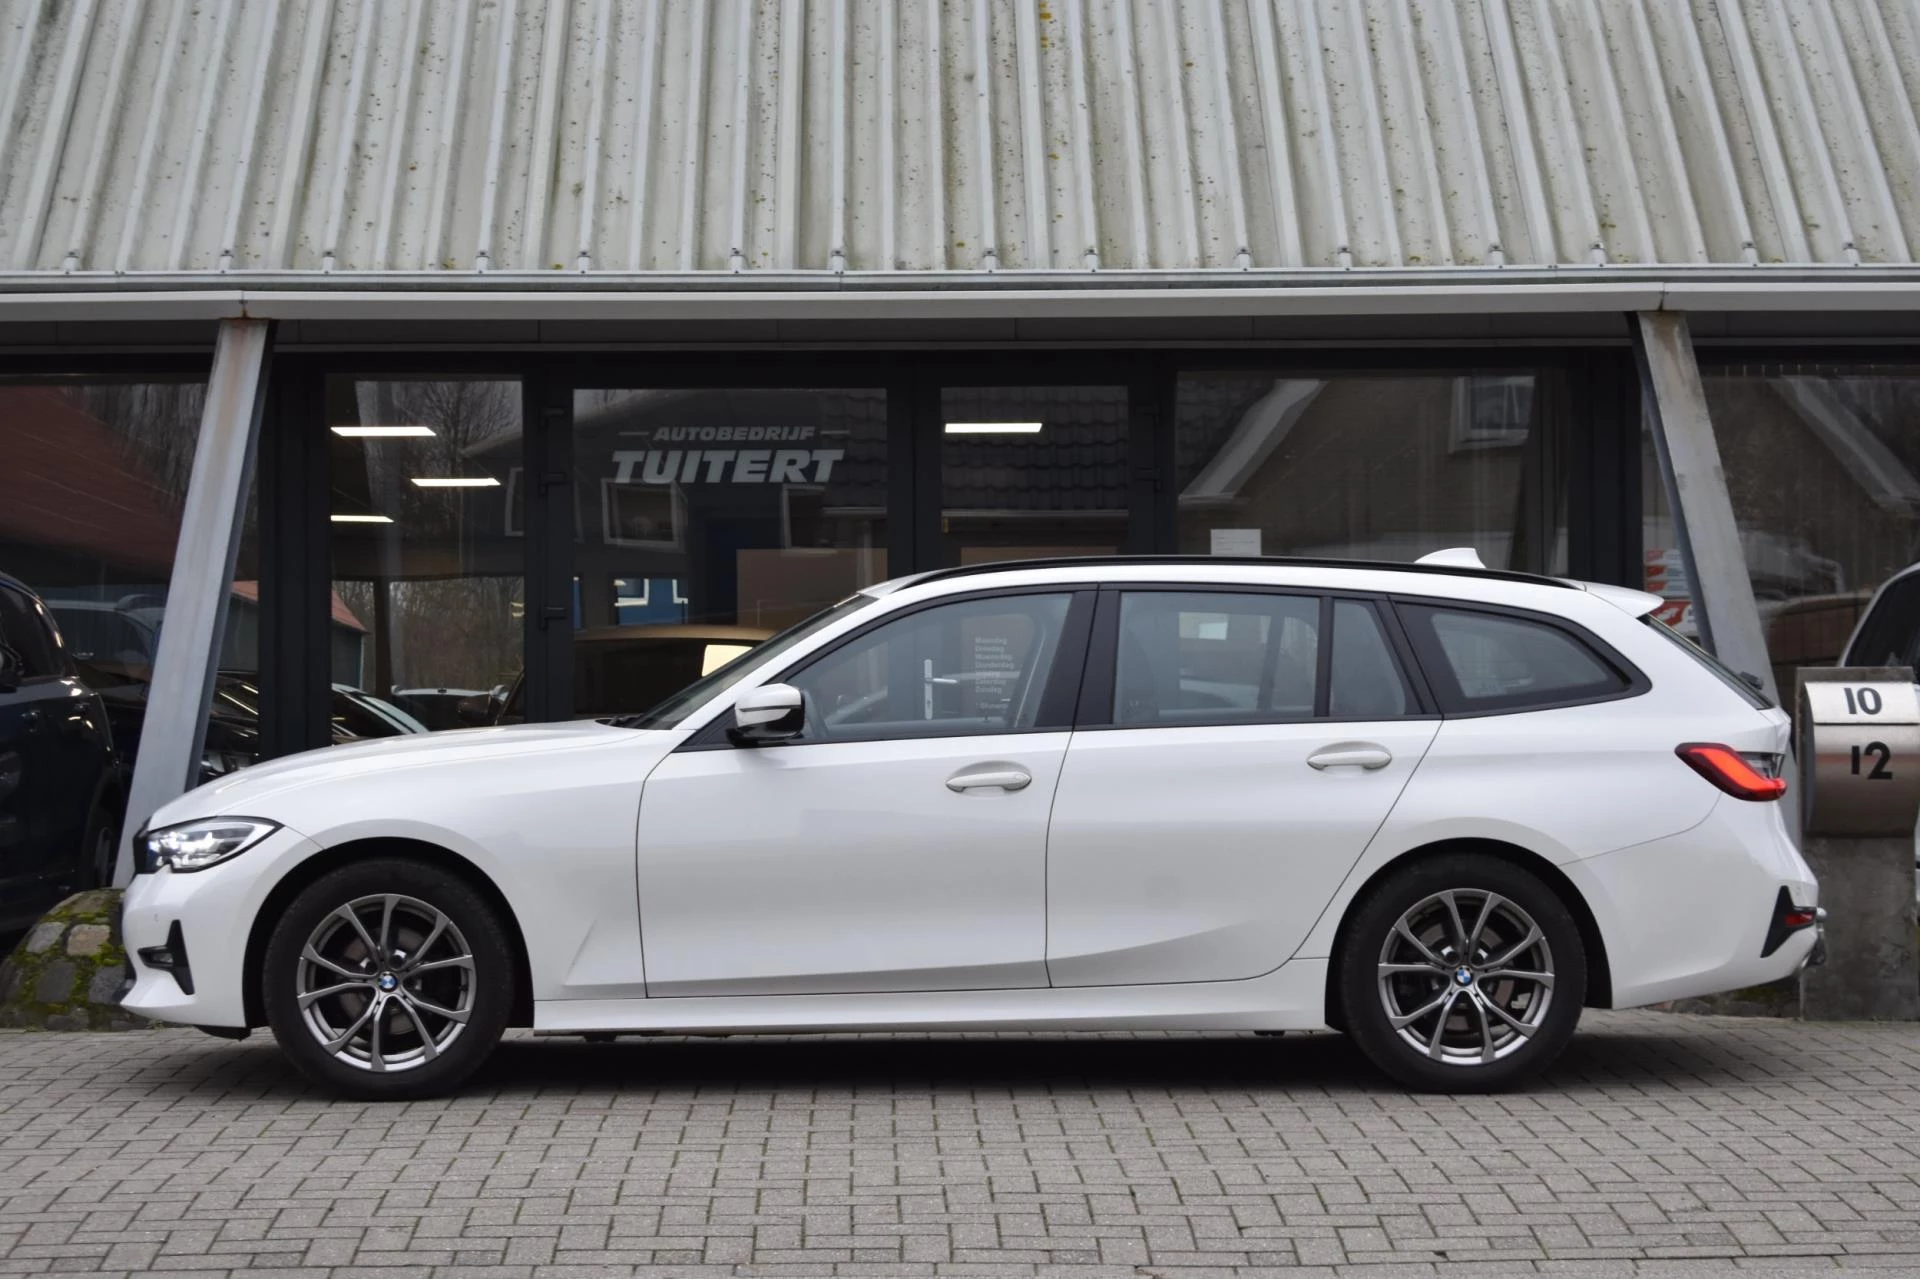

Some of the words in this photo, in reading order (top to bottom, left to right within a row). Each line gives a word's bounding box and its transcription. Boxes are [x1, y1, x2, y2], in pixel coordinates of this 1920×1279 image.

[653, 426, 816, 441] AUTOBEDRIJF
[611, 449, 845, 484] TUITERT
[1843, 687, 1882, 716] 10
[1851, 741, 1894, 780] 12
